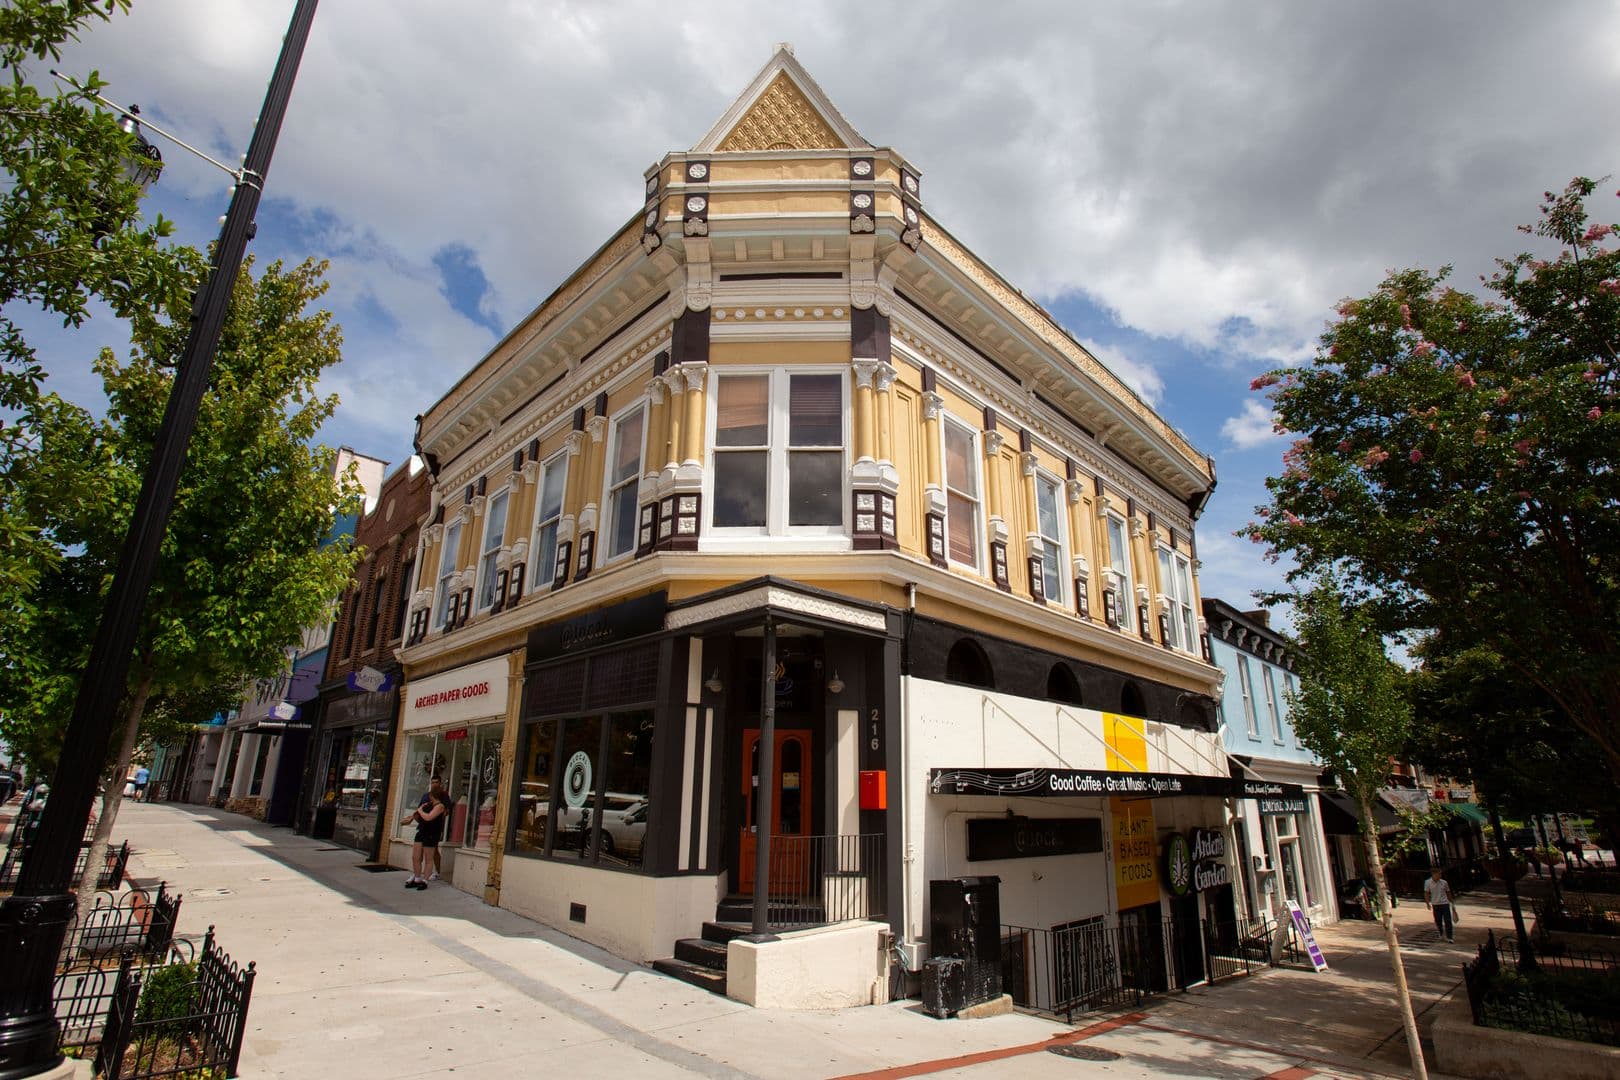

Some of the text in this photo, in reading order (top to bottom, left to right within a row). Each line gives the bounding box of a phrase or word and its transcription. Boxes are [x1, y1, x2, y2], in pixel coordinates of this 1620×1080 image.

[415, 682, 489, 709] ARCHER PAPER GOODS
[871, 709, 879, 750] 216
[1050, 774, 1181, 794] Good Coffee Great Music Open Late
[1120, 819, 1148, 836] PLANT
[1120, 840, 1151, 858] BASED
[1122, 862, 1152, 881] FOODS
[1194, 864, 1226, 891] Garden
